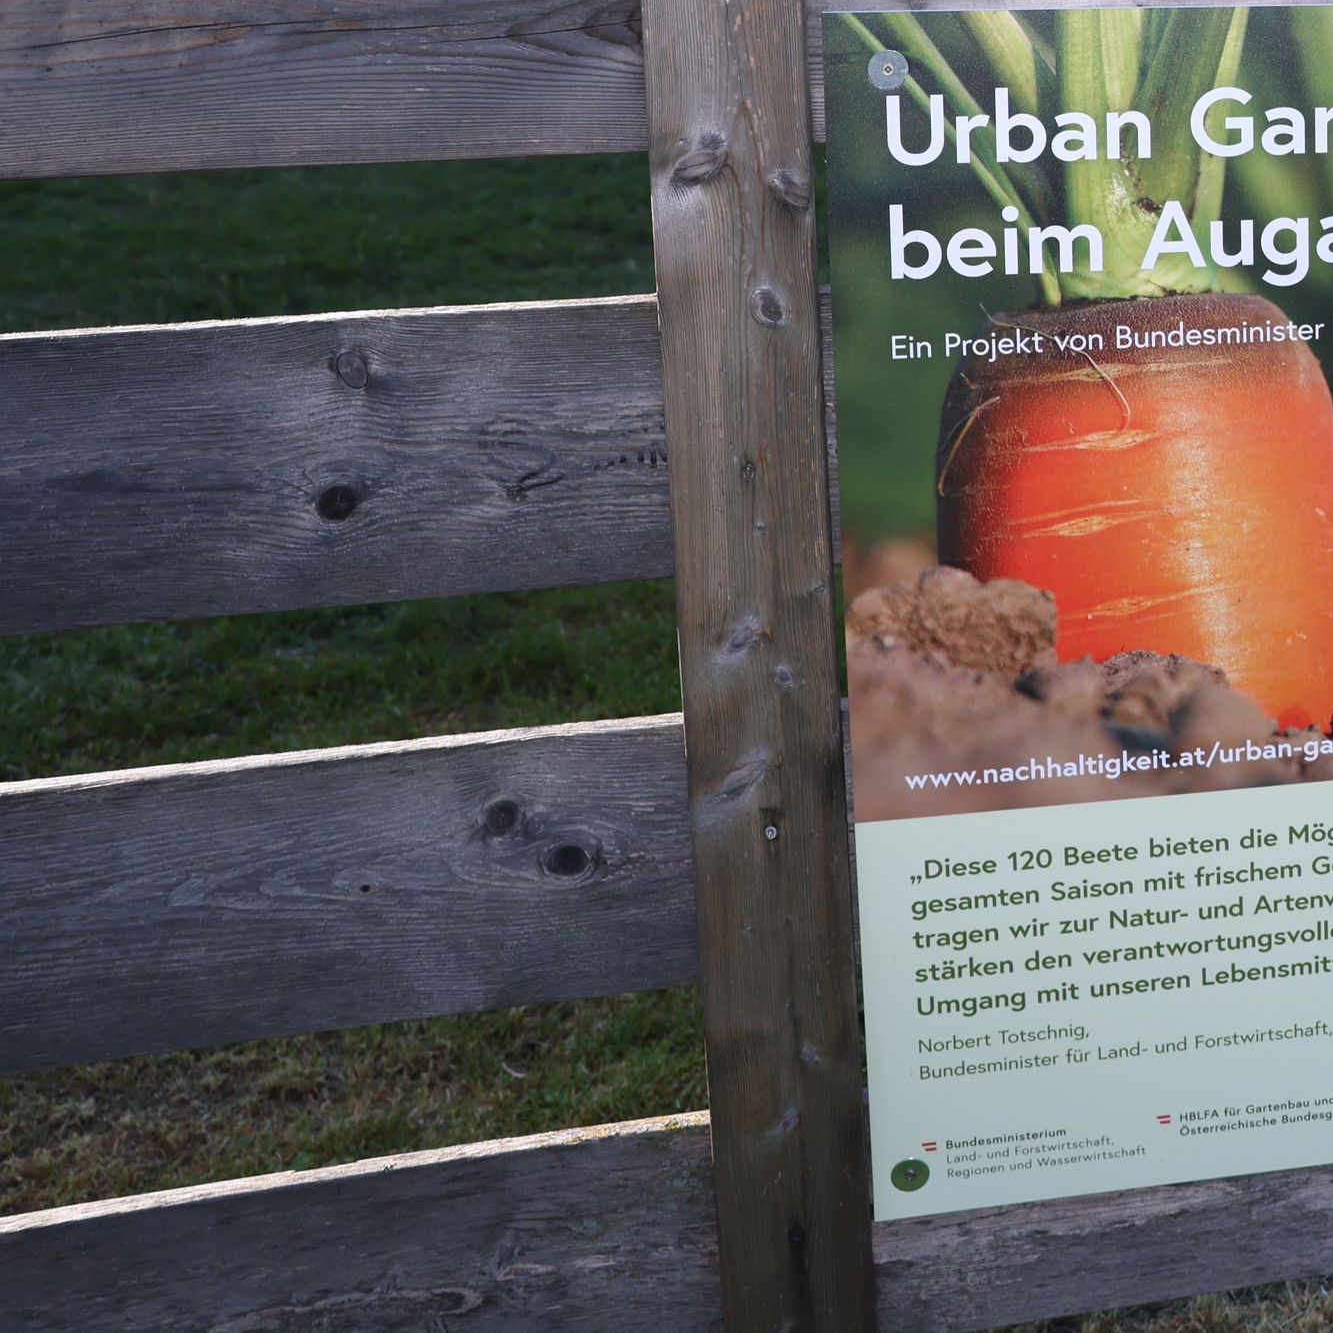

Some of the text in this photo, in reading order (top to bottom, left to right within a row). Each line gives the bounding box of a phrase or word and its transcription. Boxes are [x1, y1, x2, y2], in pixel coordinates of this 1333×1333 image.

[886, 86, 1151, 166] Urban
[890, 204, 1104, 279] beim
[892, 336, 931, 359] Ein
[946, 328, 1043, 362] Projekt
[1054, 334, 1102, 351] von
[1116, 320, 1324, 348] Bundesminister
[1008, 849, 1052, 870] 120
[1064, 845, 1138, 866] Beete
[1150, 838, 1228, 858] bieten
[1240, 828, 1277, 848] die
[912, 890, 1039, 920] gesamten
[1052, 880, 1133, 900] Saison
[1145, 872, 1184, 892] mit
[1195, 862, 1301, 886] frischem
[913, 928, 998, 950] tragen
[1010, 918, 1049, 938] wir
[1060, 918, 1098, 934] zur
[1110, 910, 1188, 928] Natur-
[1199, 896, 1243, 920] und
[916, 957, 1013, 982] stärken
[1025, 950, 1071, 970] den
[917, 992, 1026, 1016] Umgang
[1038, 982, 1079, 1003] mit
[1091, 976, 1190, 997] unseren
[919, 1024, 1088, 1053] Norbert Totschnig,
[920, 1056, 1058, 1080] Bundesminister
[1066, 1049, 1090, 1063] für
[1098, 1042, 1147, 1060] Land-
[1156, 1036, 1186, 1053] und
[1196, 1021, 1332, 1049] Forstwirtschaft,
[1180, 1110, 1218, 1122] HBLFA
[1224, 1108, 1240, 1116] für
[1246, 1100, 1309, 1114] Gartenbau
[1180, 1117, 1276, 1136] Österreichische
[946, 1130, 1066, 1150] Bundesministerium
[947, 1135, 1114, 1164] Land- und Forstwirtschaft,
[948, 1144, 1145, 1178] Regionen und Wasserwirtschaft
